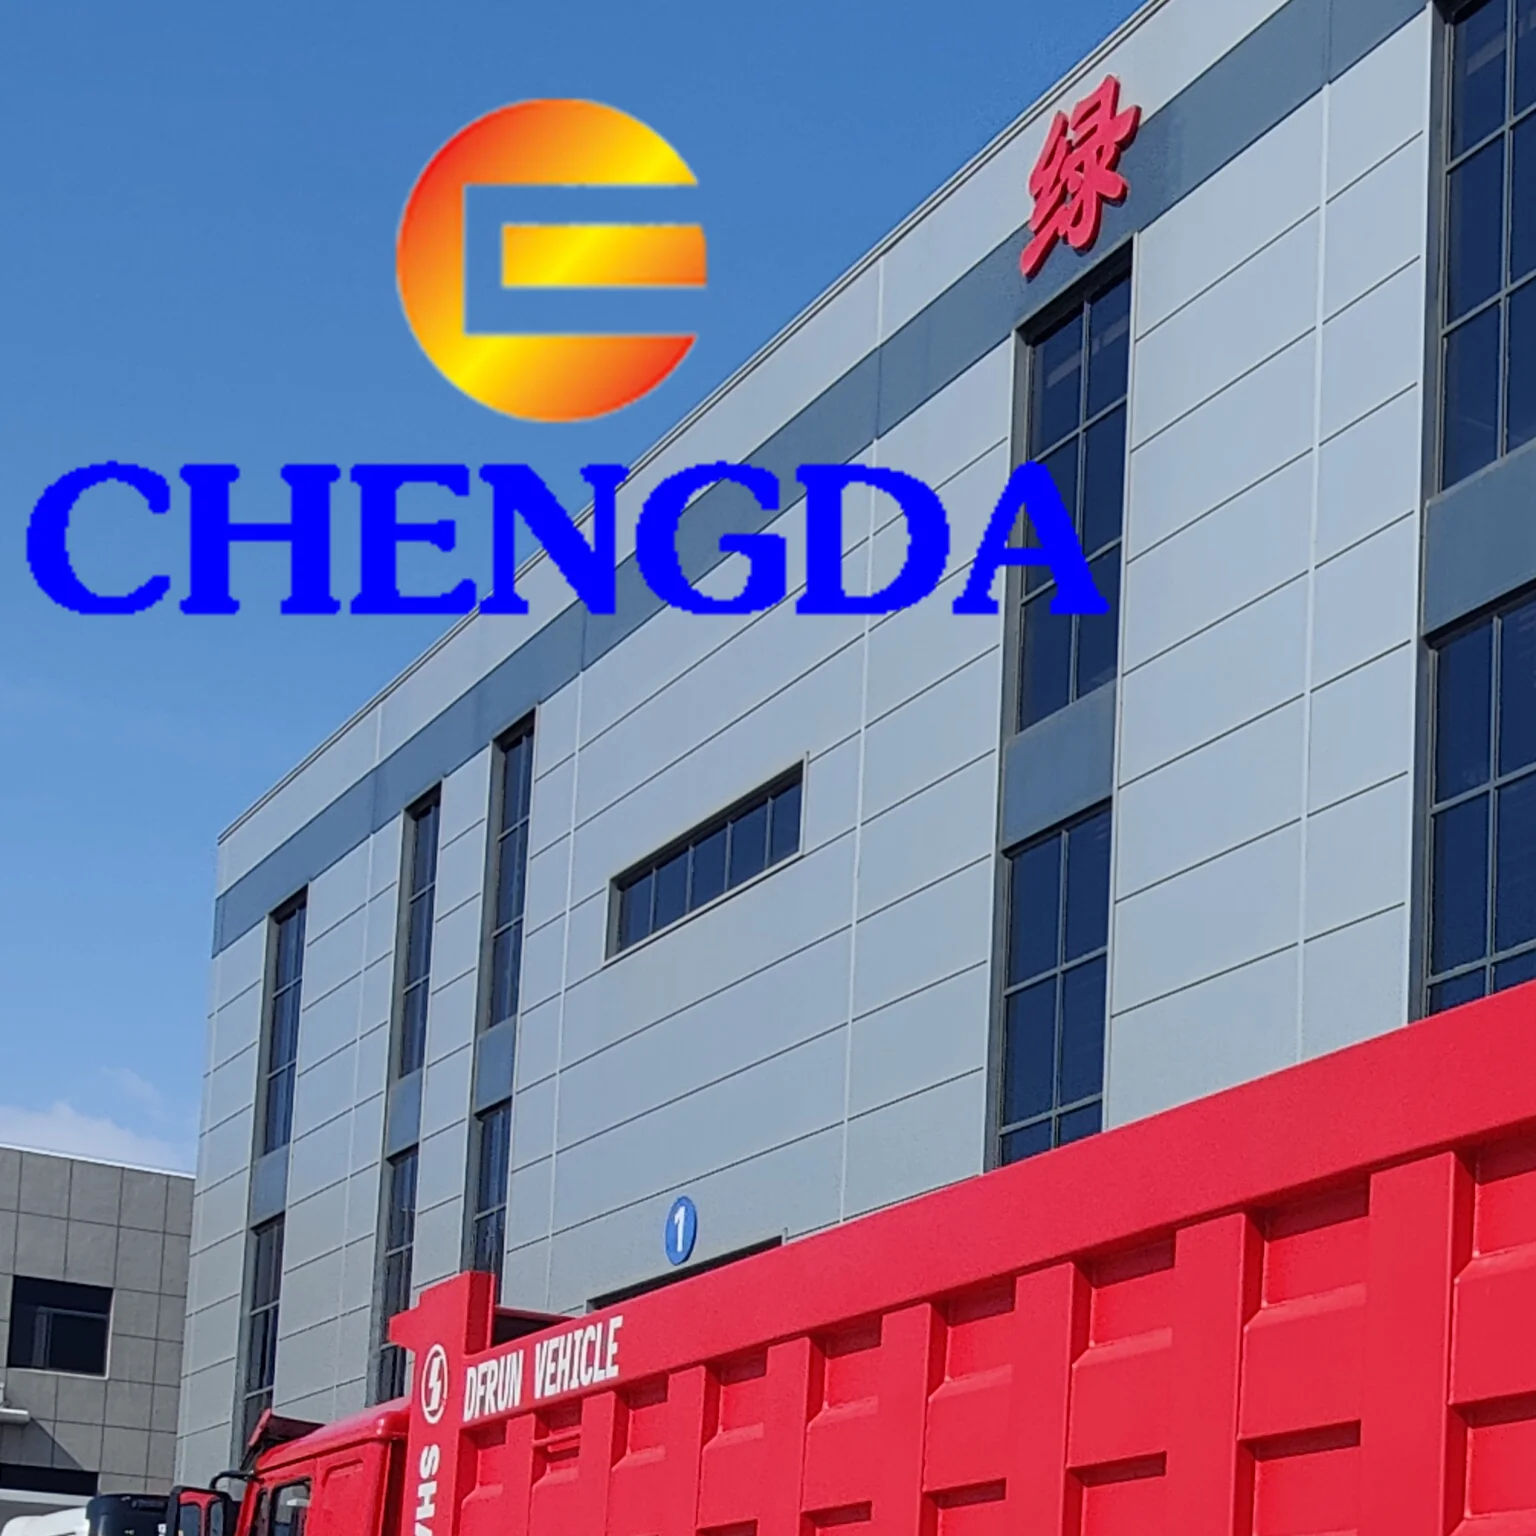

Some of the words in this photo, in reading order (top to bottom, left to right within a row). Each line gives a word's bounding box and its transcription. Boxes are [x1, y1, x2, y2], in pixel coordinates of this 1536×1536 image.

[1019, 74, 1142, 282] 绿
[674, 1206, 686, 1252] 1
[463, 1350, 524, 1422] DFRUN
[533, 1315, 623, 1399] VEHICLE
